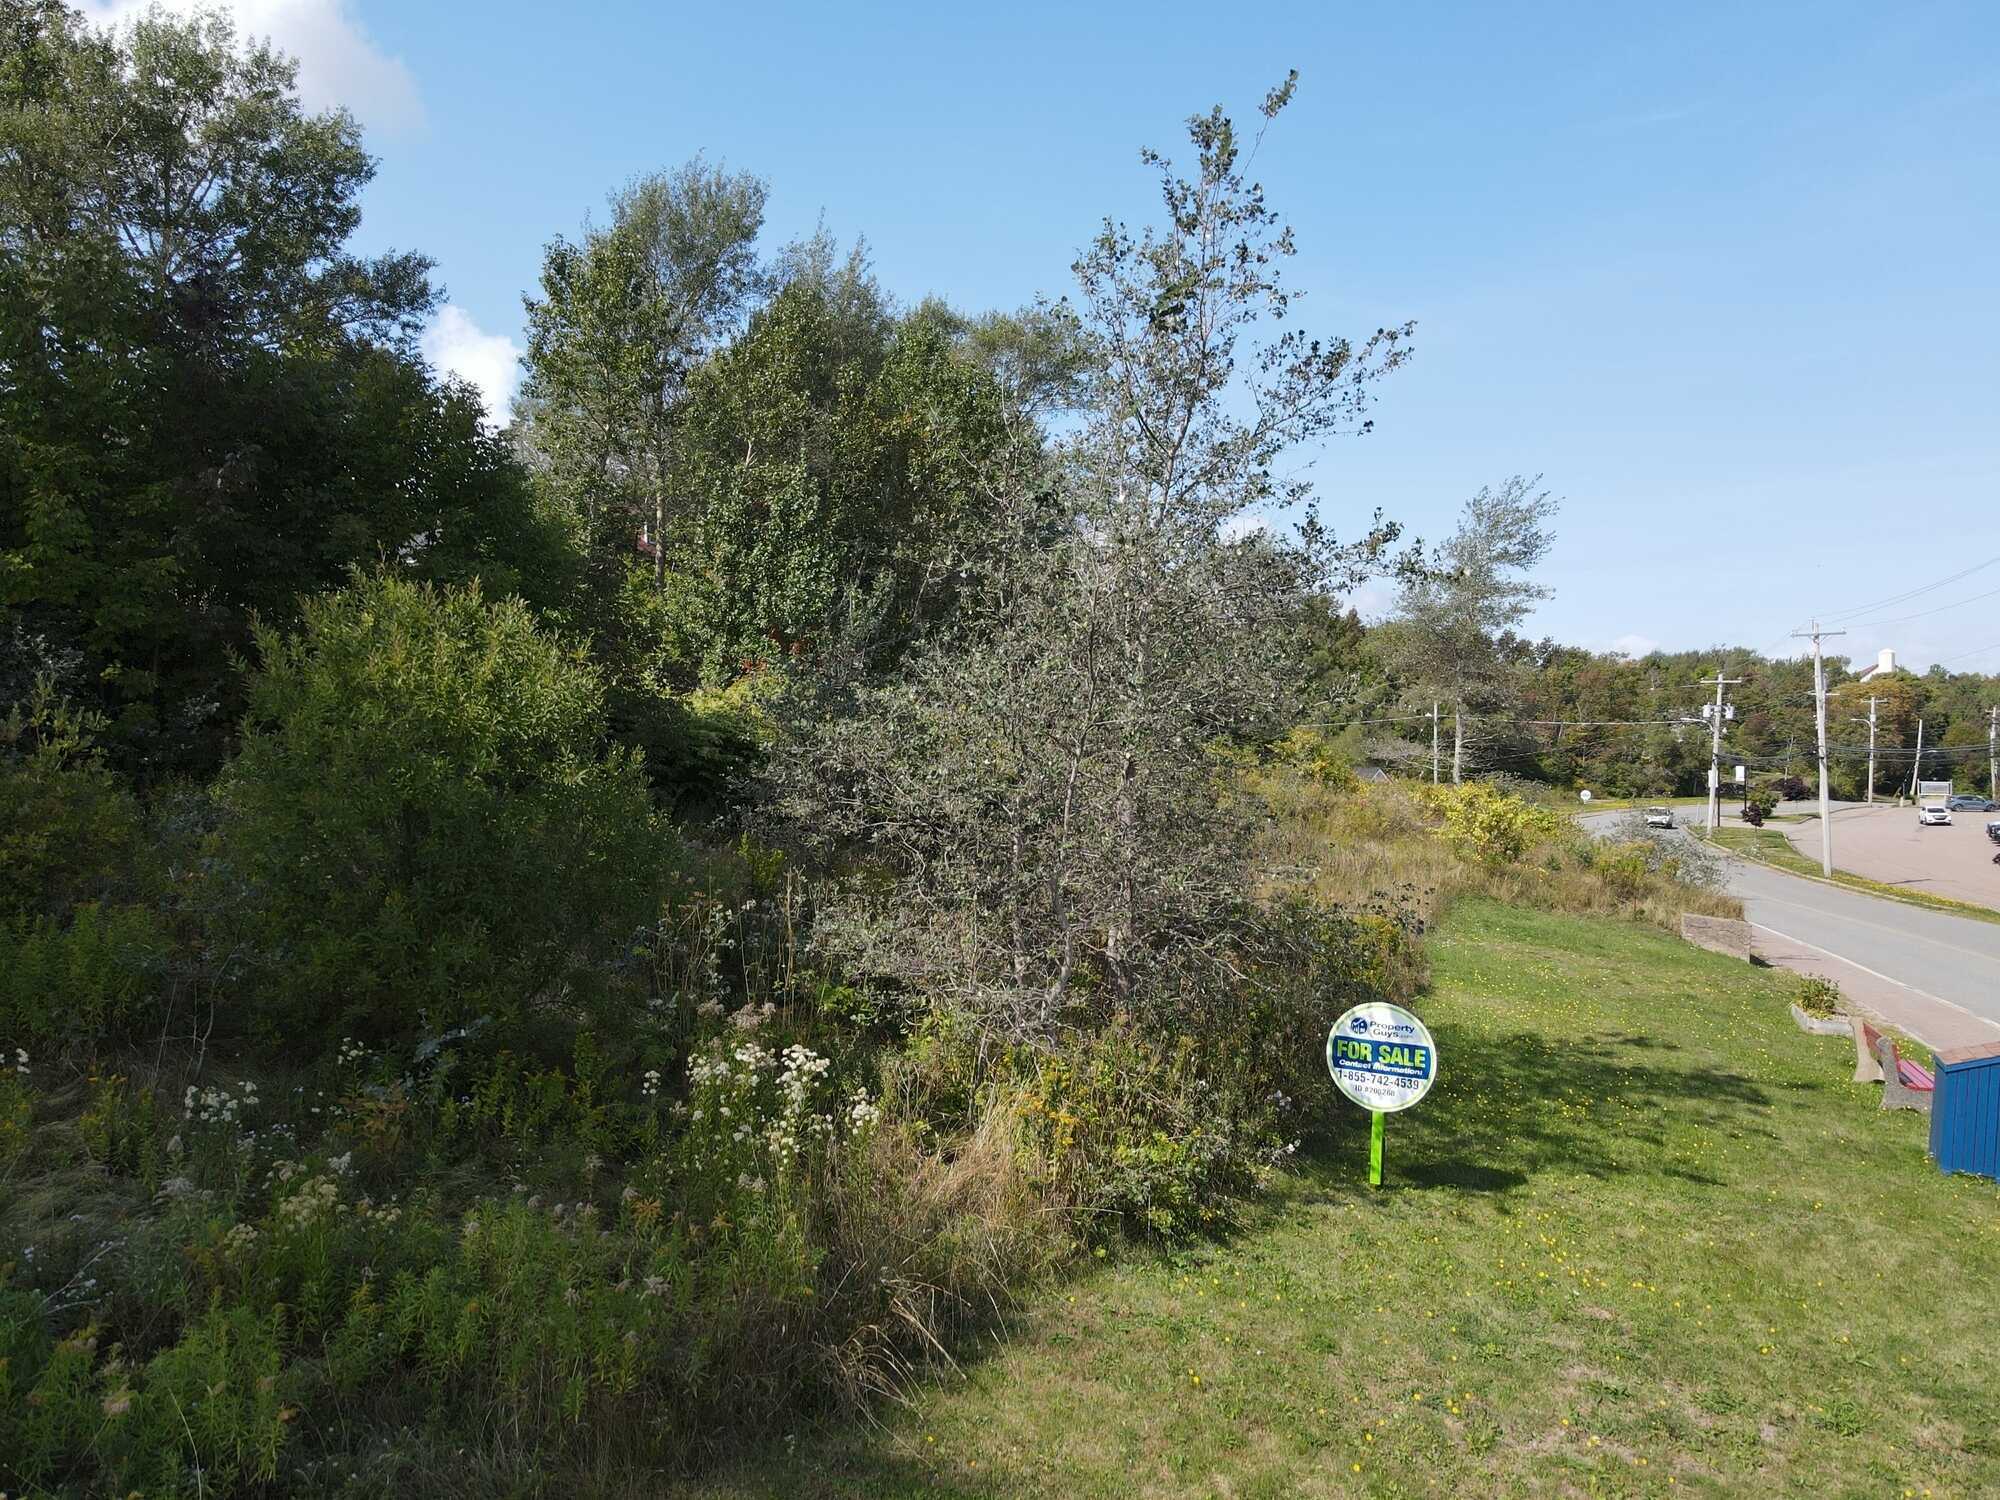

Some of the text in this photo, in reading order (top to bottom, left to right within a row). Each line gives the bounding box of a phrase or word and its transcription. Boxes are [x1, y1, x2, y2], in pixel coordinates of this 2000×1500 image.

[1369, 1020, 1415, 1034] Property
[1337, 1039, 1426, 1068] FOR SALE
[1339, 1059, 1371, 1069] Contact
[1338, 1069, 1420, 1090] 1-855-742-4539
